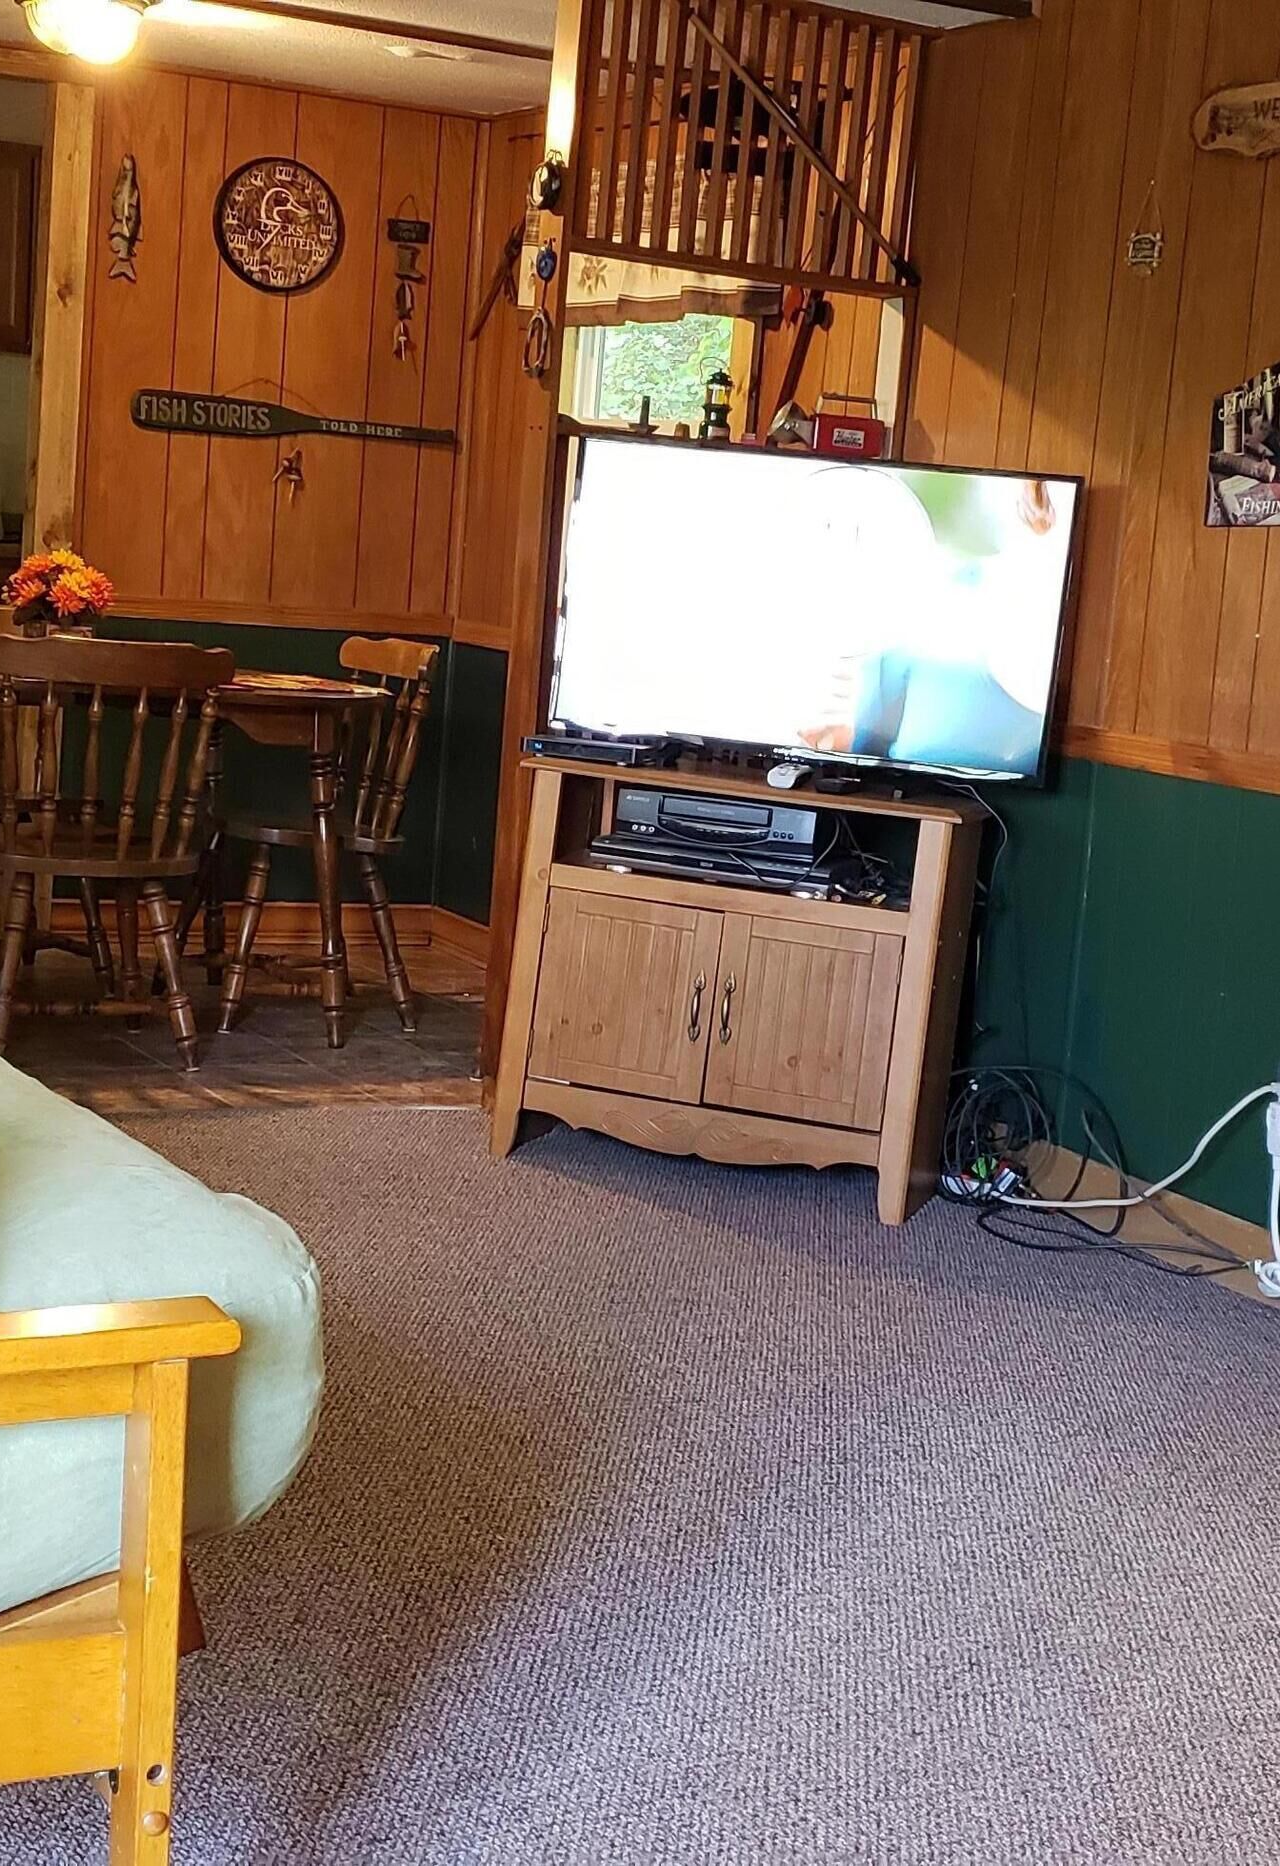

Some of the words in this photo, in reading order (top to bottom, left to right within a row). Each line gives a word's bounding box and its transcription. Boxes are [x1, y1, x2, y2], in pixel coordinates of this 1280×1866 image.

[138, 395, 187, 424] FISH
[192, 400, 272, 431] STORIES
[320, 420, 359, 433] TOLD
[366, 424, 403, 438] HERE
